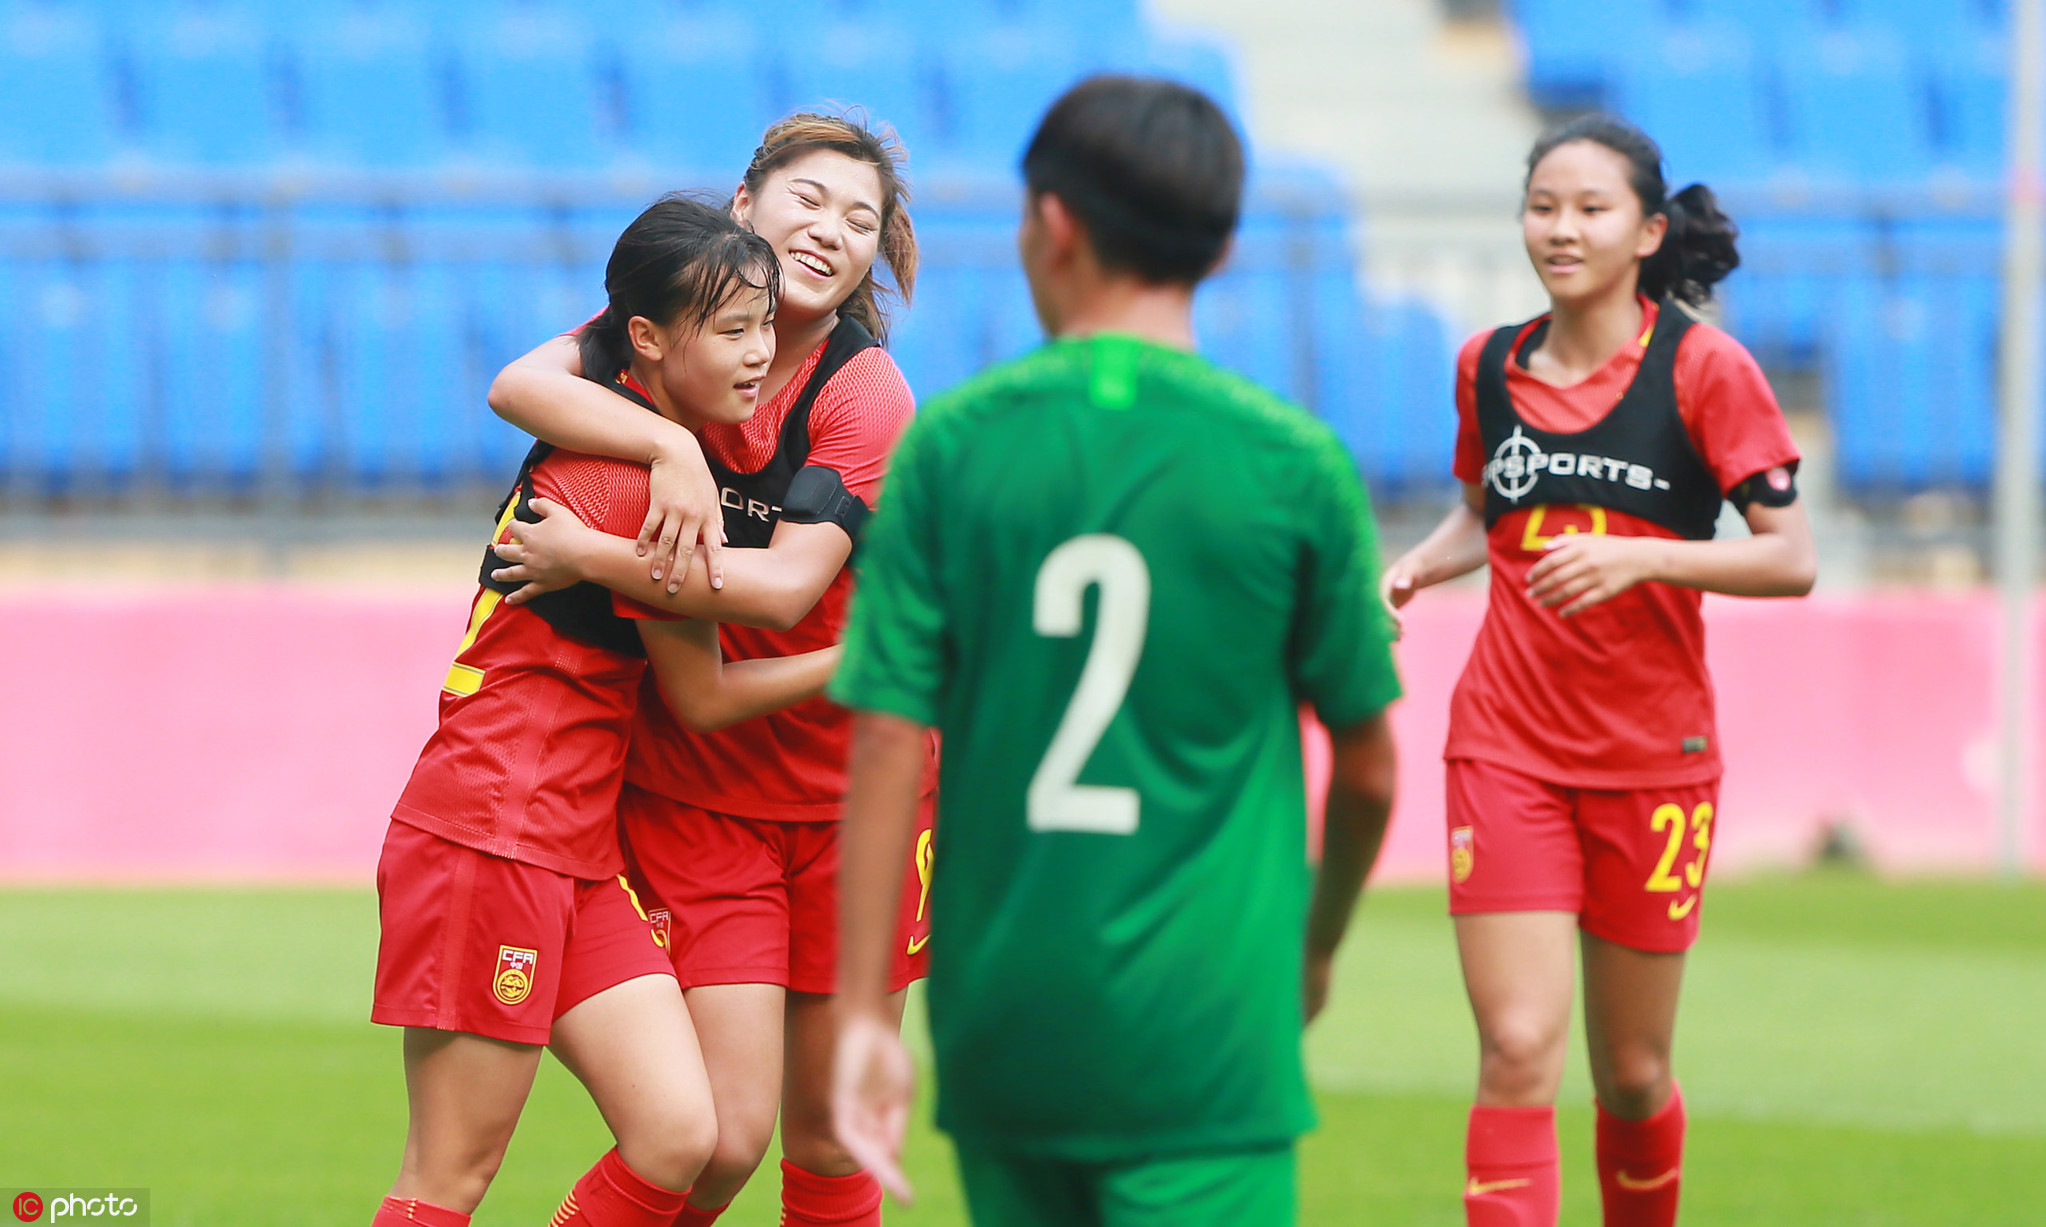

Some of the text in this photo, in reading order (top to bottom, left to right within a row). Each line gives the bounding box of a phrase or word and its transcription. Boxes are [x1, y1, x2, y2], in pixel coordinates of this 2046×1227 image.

[1025, 532, 1151, 836] 2
[915, 828, 935, 922] 9
[1644, 801, 1714, 892] 23
[502, 949, 534, 965] CFA
[649, 911, 669, 924] CFA
